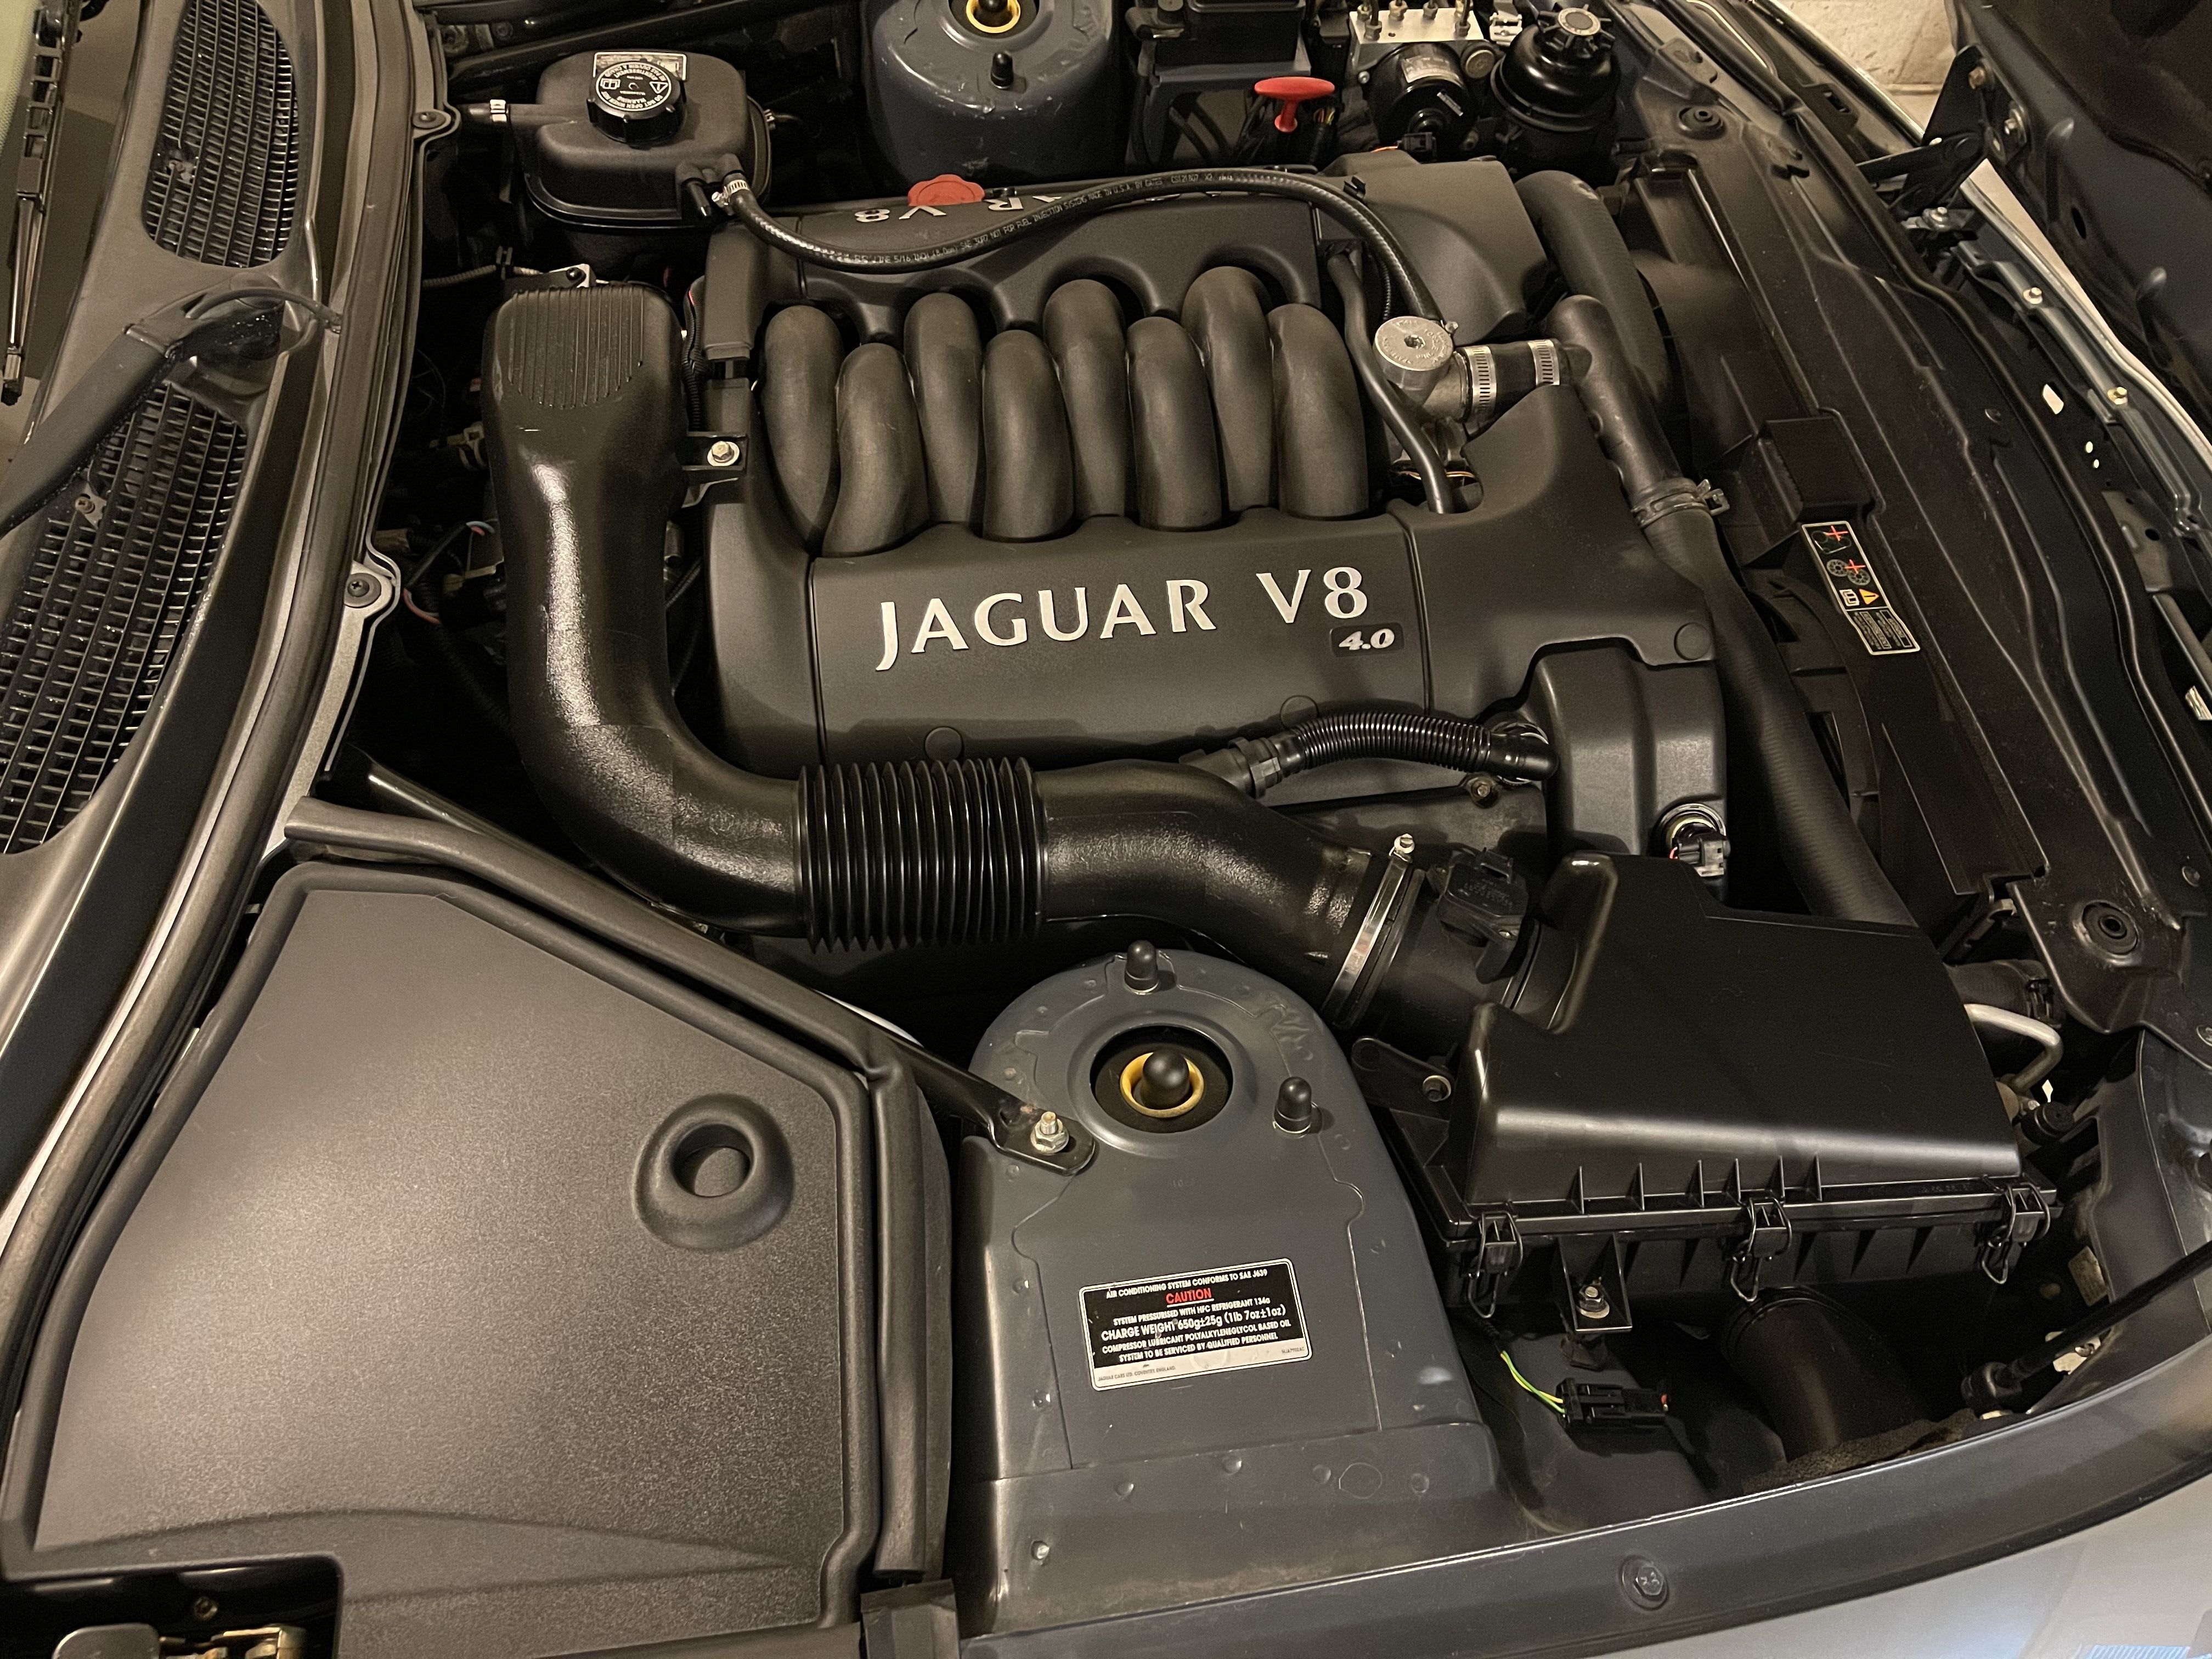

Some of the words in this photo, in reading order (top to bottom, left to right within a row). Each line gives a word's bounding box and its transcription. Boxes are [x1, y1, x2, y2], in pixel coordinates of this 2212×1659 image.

[990, 229, 1001, 239] NOT
[1003, 224, 1014, 234] FOR
[1016, 218, 1031, 229] FUEL
[1033, 205, 1063, 222] INJECTION
[1065, 196, 1087, 209] SYSTEMS
[1145, 177, 1163, 187] GATES
[876, 579, 1216, 672] JAGUAR
[1256, 567, 1368, 624] V8
[1339, 628, 1395, 651] 4.0
[1106, 1290, 1118, 1299] AIR
[1118, 1283, 1167, 1297] CONDITIONING
[1168, 1279, 1191, 1290] SYSTEM
[1192, 1274, 1229, 1286] CONFORMS
[1229, 1273, 1239, 1281] TO
[1239, 1271, 1251, 1280] SAE
[1252, 1268, 1268, 1278] J639
[1166, 1288, 1212, 1304] CAUTION
[1101, 1326, 1140, 1341] CHARGE
[1141, 1321, 1175, 1335] WEIGHT
[1177, 1314, 1223, 1330] 650g±25g
[1224, 1311, 1243, 1324] (1lb
[1244, 1304, 1286, 1321] 7oz±1oz)
[1113, 1316, 1137, 1325] SYSTEM
[1138, 1310, 1178, 1322] PRESSURISED
[1179, 1307, 1196, 1316] WITH
[1197, 1305, 1211, 1314] HFC
[1211, 1298, 1253, 1312] REFRIGERANT
[1254, 1296, 1271, 1306] 134a
[1102, 1340, 1147, 1354] COMPRESSOR
[1148, 1334, 1184, 1347] LUBRICANT
[1185, 1324, 1257, 1342] POLYALKYLENEGLYCOL
[1258, 1321, 1279, 1331] BASED
[1279, 1319, 1291, 1328] OIL
[1119, 1351, 1143, 1362] SYSTEM
[1144, 1350, 1154, 1358] TO
[1154, 1348, 1163, 1357] BE
[1164, 1344, 1196, 1356] SERVICED
[1197, 1342, 1206, 1351] BY
[1207, 1337, 1240, 1349] QUALIFIED
[1241, 1331, 1278, 1344] PERSONNEL
